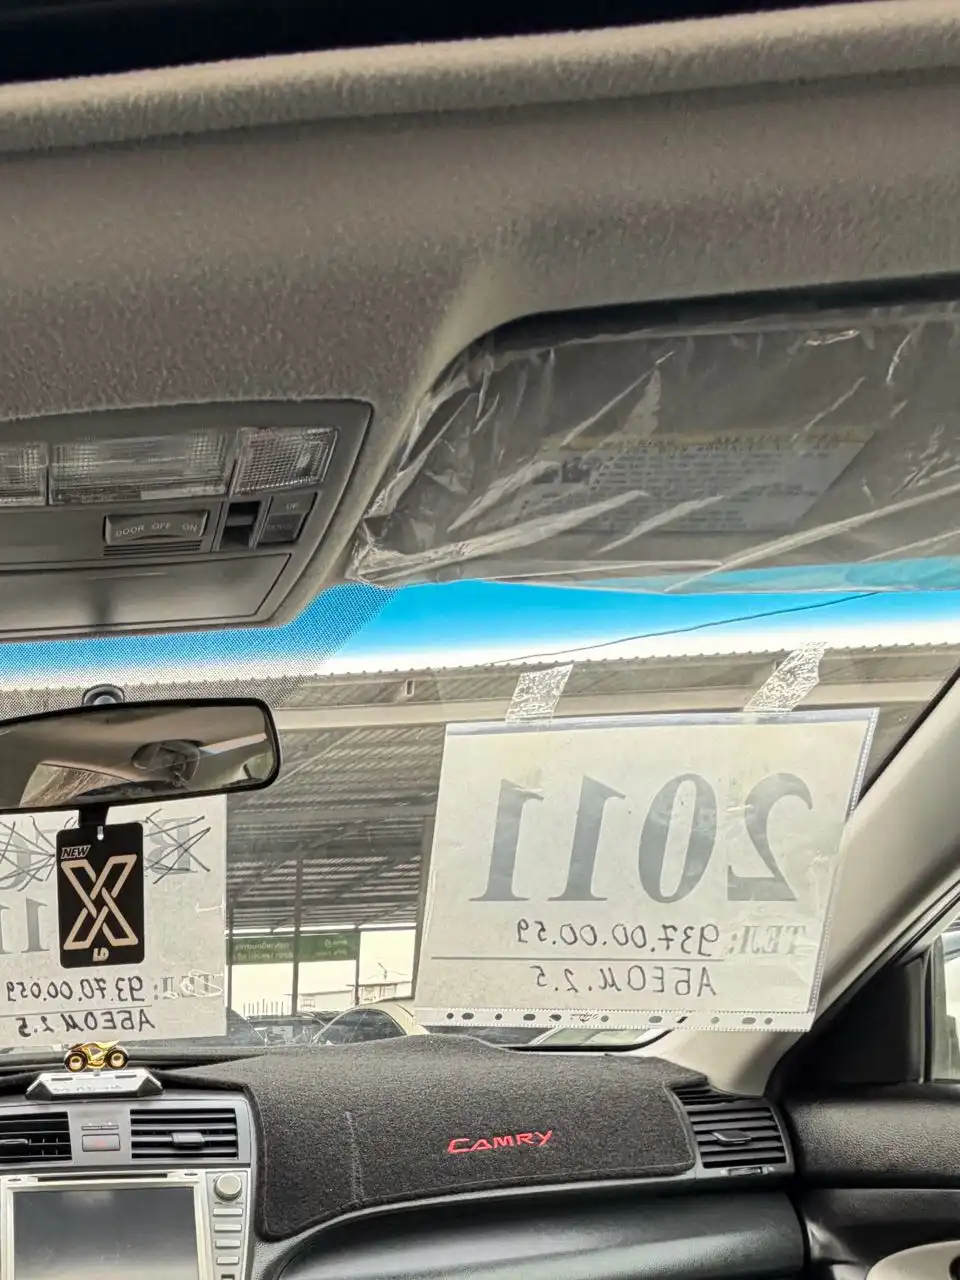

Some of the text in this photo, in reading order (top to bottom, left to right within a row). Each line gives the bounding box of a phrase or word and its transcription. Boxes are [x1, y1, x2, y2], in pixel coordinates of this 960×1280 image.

[115, 521, 198, 537] DOOR OFF ON
[61, 845, 91, 860] NEW
[447, 1129, 553, 1154] CAMRY
